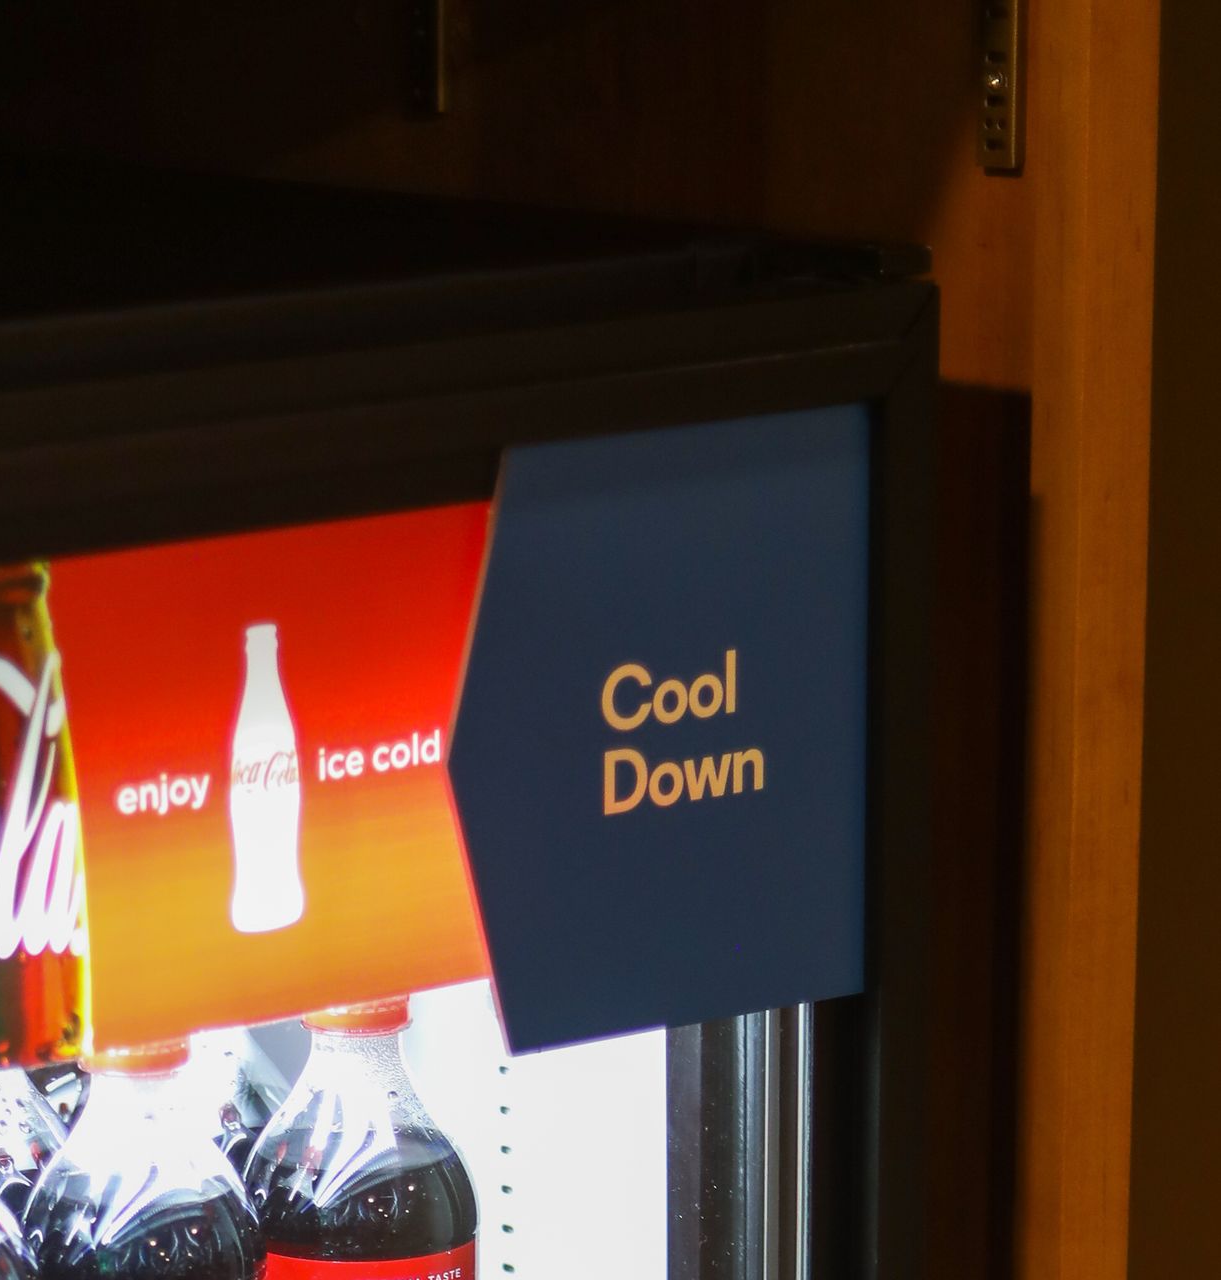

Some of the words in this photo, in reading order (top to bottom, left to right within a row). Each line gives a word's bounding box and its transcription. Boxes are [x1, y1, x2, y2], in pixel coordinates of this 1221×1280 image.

[601, 649, 737, 731] Cool
[318, 748, 364, 782] ice
[372, 729, 441, 772] cold
[603, 748, 765, 816] Down
[117, 773, 210, 815] enjoy
